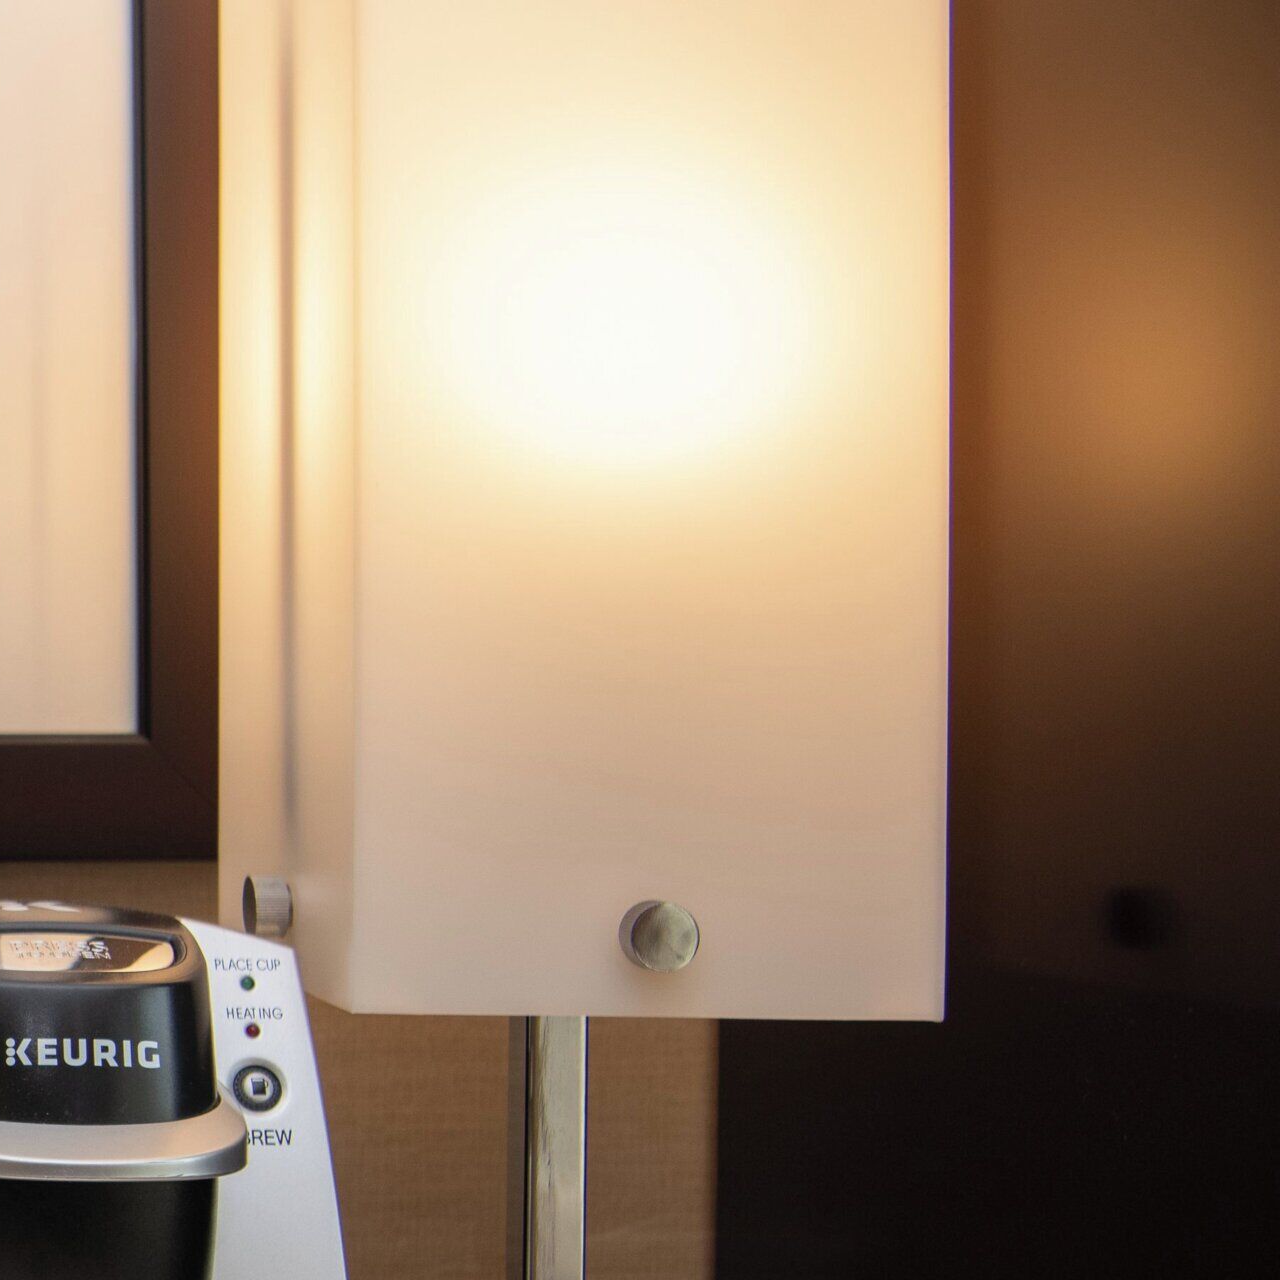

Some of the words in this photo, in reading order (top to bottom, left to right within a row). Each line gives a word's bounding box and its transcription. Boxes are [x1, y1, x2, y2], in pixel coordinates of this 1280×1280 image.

[214, 957, 253, 972] PLACE
[256, 957, 281, 971] CUP
[226, 1007, 283, 1020] HEATING
[5, 1037, 161, 1069] KEURIG
